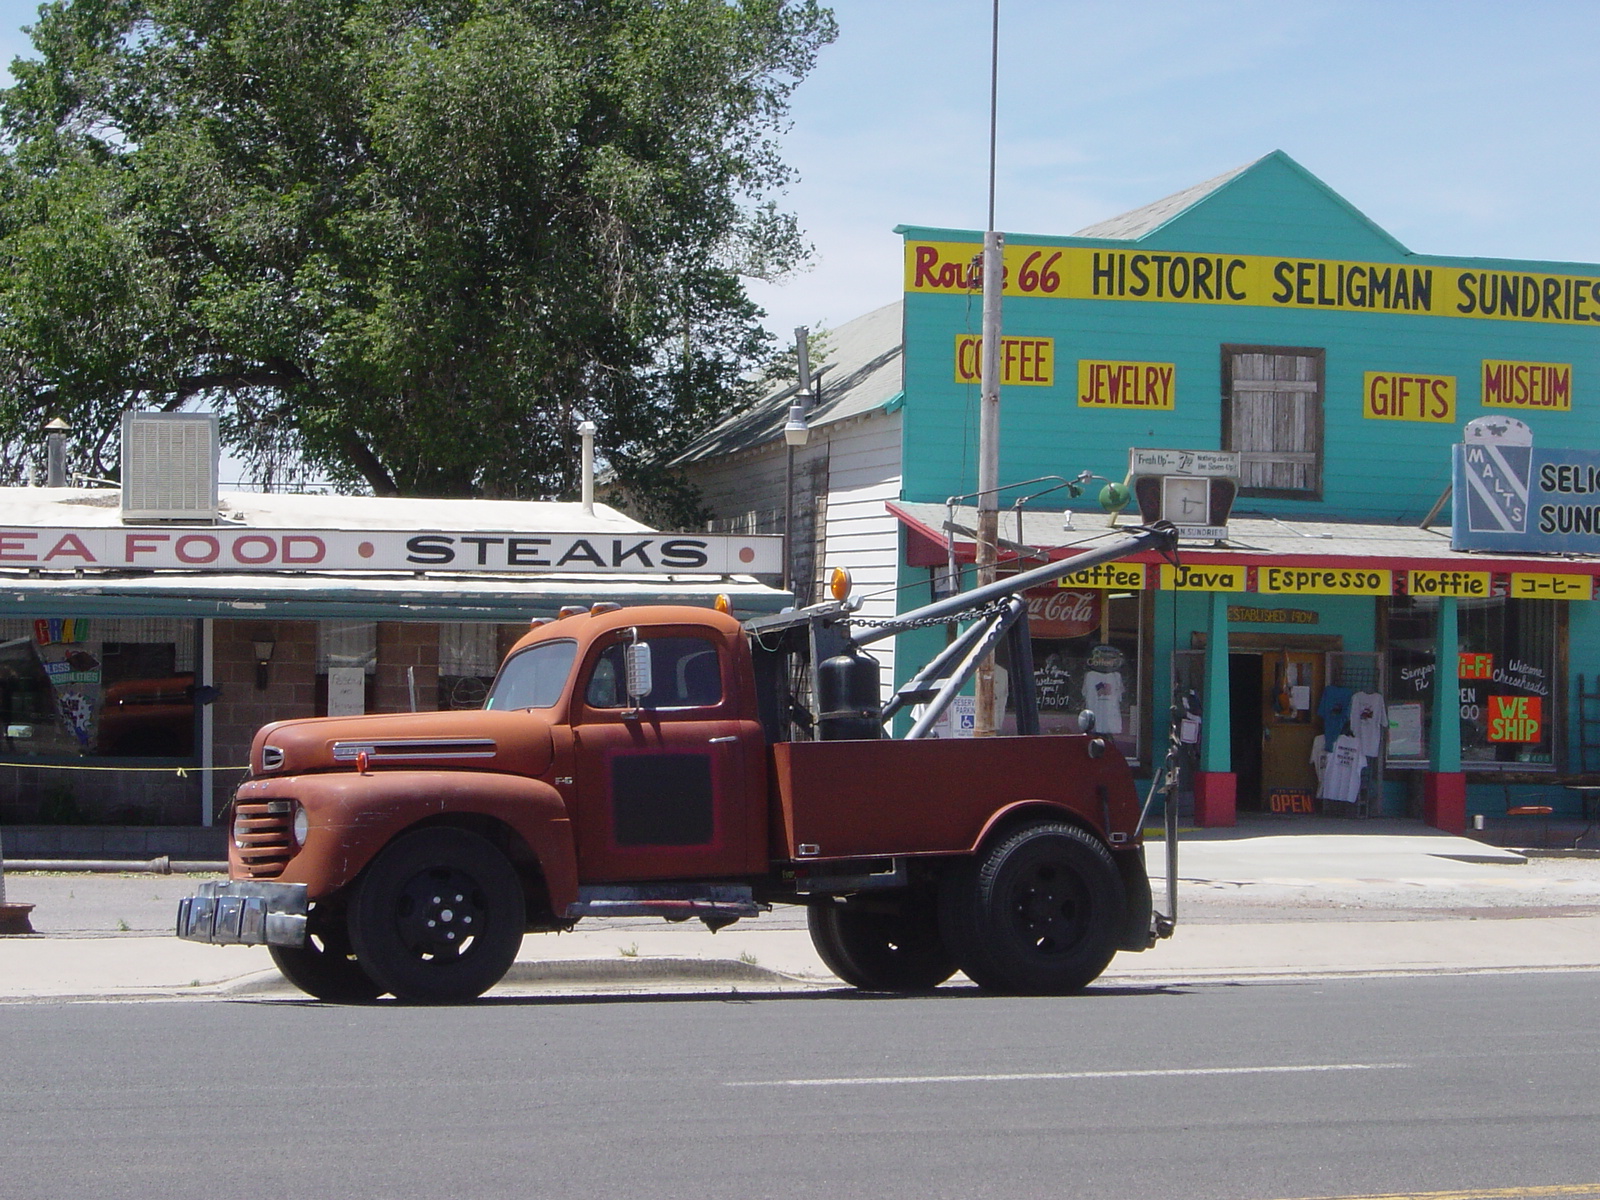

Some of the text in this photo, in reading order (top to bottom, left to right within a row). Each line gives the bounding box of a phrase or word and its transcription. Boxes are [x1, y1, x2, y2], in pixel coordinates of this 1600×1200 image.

[914, 246, 1008, 289] Rou
[1018, 251, 1063, 293] 66
[1093, 252, 1247, 301] HISTORIC
[1272, 260, 1433, 311] SELIGMAN
[958, 338, 1049, 382] COFEE
[1081, 364, 1173, 406] JEWELRY
[1485, 363, 1569, 407] MUSEUM
[1370, 375, 1449, 419] GIFTS
[1468, 448, 1523, 522] MALTS
[1187, 527, 1224, 536] SUNDRIES
[124, 533, 327, 564] FOOD
[405, 534, 709, 568] STEAKS
[1174, 566, 1234, 588] Java
[1268, 568, 1382, 591] Espresso
[1413, 572, 1484, 595] Koffie
[1521, 577, 1582, 595] コーヒー
[1227, 608, 1288, 622] ESTABLISHED
[1401, 663, 1436, 680] Semper
[1458, 655, 1491, 677] i-Fi
[1509, 658, 1546, 679] Welcome
[1493, 668, 1549, 696] Cheeseheads
[1458, 688, 1476, 703] EN
[1497, 696, 1529, 719] WE
[1490, 718, 1539, 741] SHIP
[1271, 794, 1313, 813] OPEN
